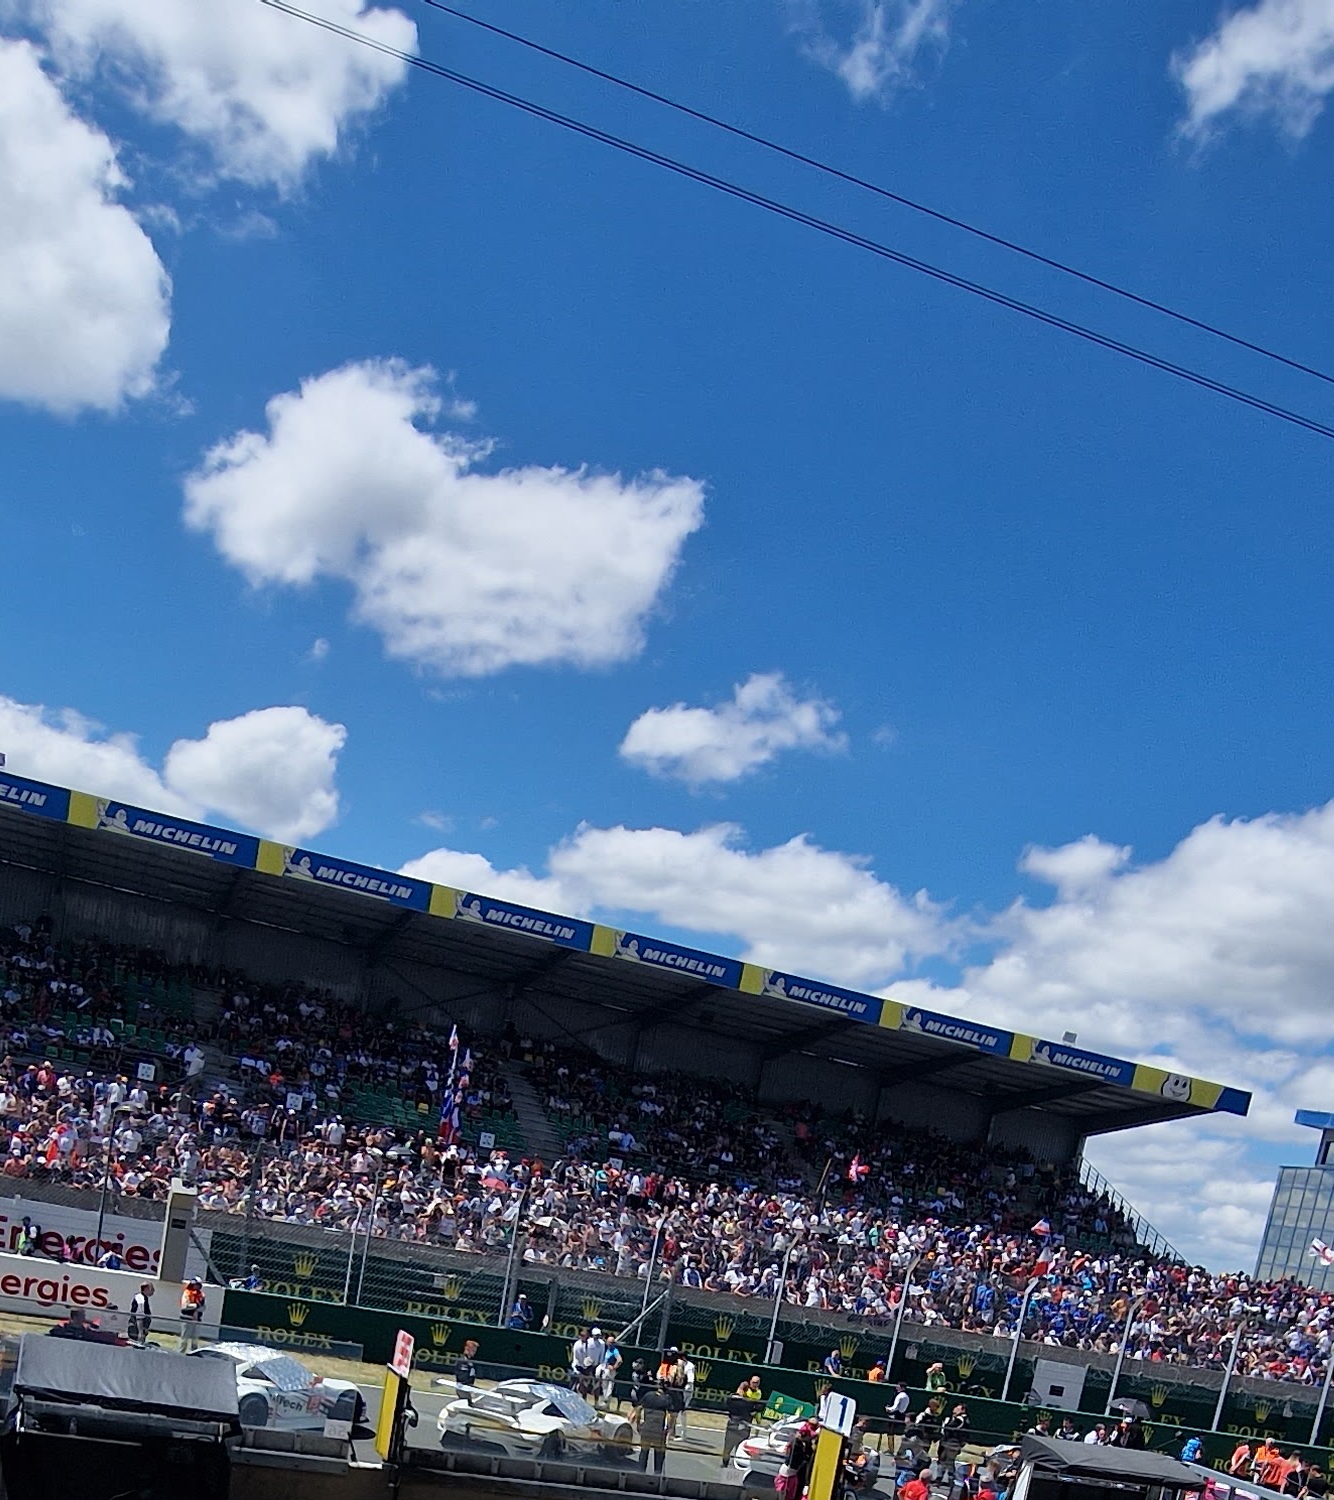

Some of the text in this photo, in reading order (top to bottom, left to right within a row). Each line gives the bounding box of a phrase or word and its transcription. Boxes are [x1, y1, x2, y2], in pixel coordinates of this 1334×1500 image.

[132, 818, 238, 856] MICHELIN
[314, 865, 414, 900] MICHELIN
[485, 908, 576, 941] MICHELIN
[642, 948, 727, 979] MICHELIN
[787, 985, 868, 1015] MICHELIN
[923, 1019, 999, 1048] MICHELIN
[1051, 1052, 1122, 1078] MICHELIN
[837, 1397, 849, 1429] 1
